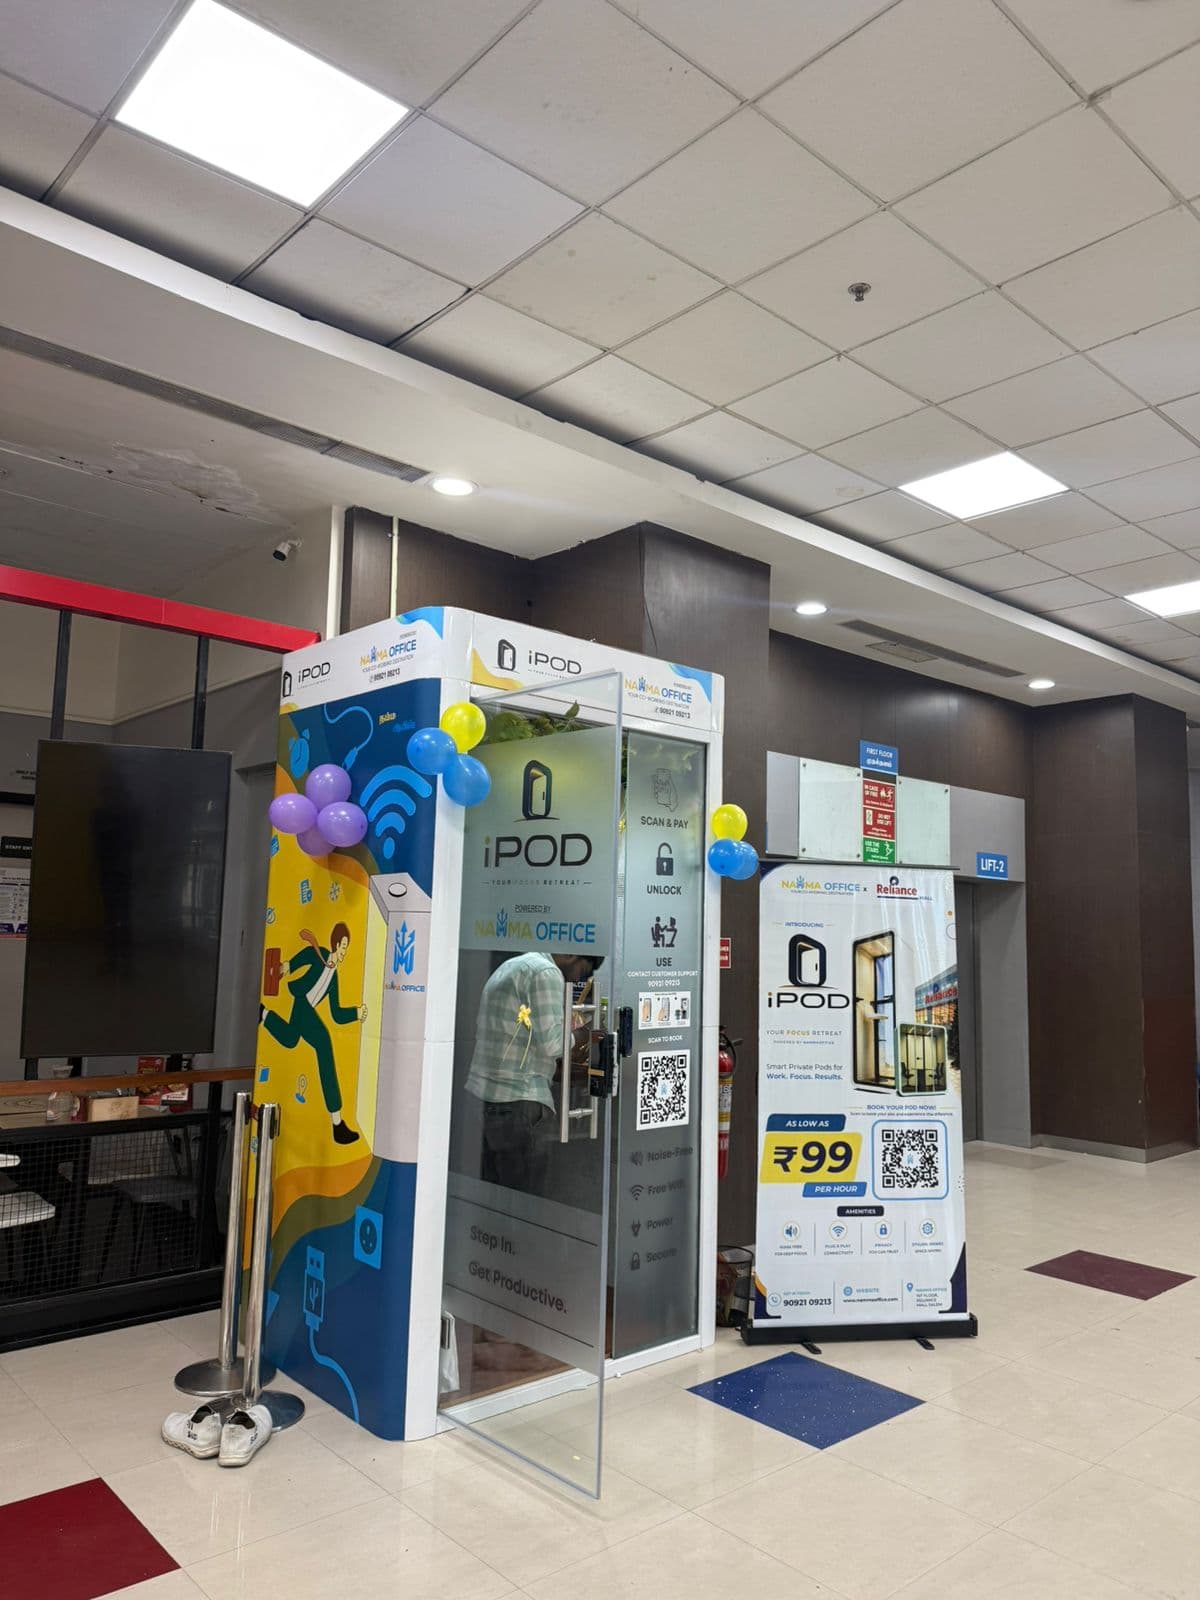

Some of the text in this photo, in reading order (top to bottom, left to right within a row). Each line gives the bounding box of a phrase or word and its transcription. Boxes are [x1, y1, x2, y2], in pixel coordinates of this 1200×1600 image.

[389, 639, 416, 657] OFFICE
[529, 650, 581, 675] iPOD
[298, 662, 331, 683] iPOD
[661, 687, 692, 703] OFFICE
[640, 816, 689, 829] SCAN & PAY
[484, 833, 592, 868] iPOD
[981, 858, 1004, 872] LIFT-2
[646, 884, 682, 896] UNLOCK
[824, 882, 860, 892] OFFICE
[876, 884, 918, 896] Reliance
[514, 905, 551, 913] POWERED BY
[536, 921, 596, 944] OFFICE
[656, 957, 673, 967] USE
[768, 992, 850, 1009] iPOD
[789, 1063, 813, 1071] Private
[814, 1063, 832, 1071] Pods
[833, 1063, 843, 1071] for
[773, 1141, 853, 1174] ₹99
[647, 1184, 667, 1196] Free
[646, 1217, 674, 1231] Power
[469, 1225, 516, 1256] Step In.
[468, 1261, 567, 1314] Get Productive.
[783, 1298, 832, 1307] 90921 09213
